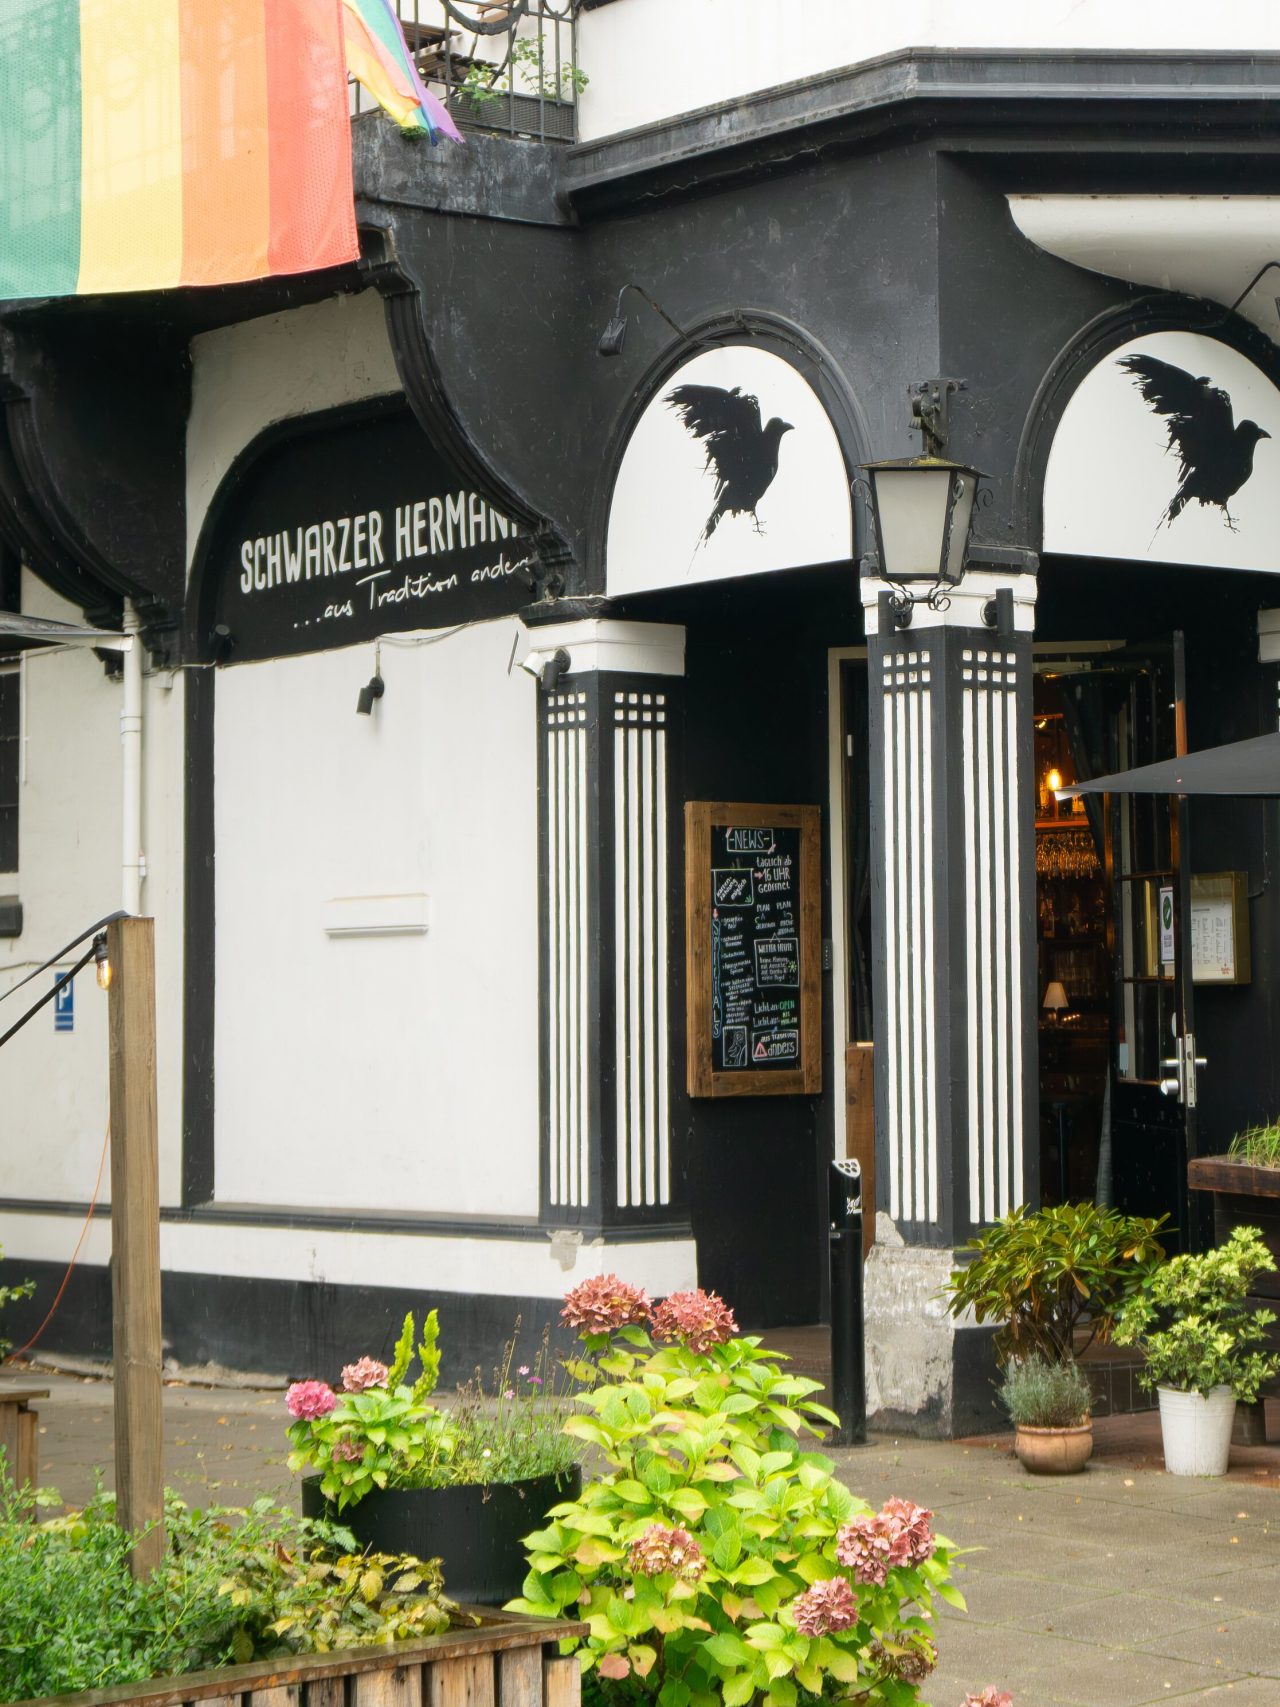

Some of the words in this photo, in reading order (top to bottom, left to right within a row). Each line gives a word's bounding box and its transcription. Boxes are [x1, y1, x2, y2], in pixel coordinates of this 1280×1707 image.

[241, 511, 384, 595] SCHWARZER
[395, 490, 518, 563] HERMAN
[356, 570, 457, 611] Tradition
[763, 868, 772, 882] 16
